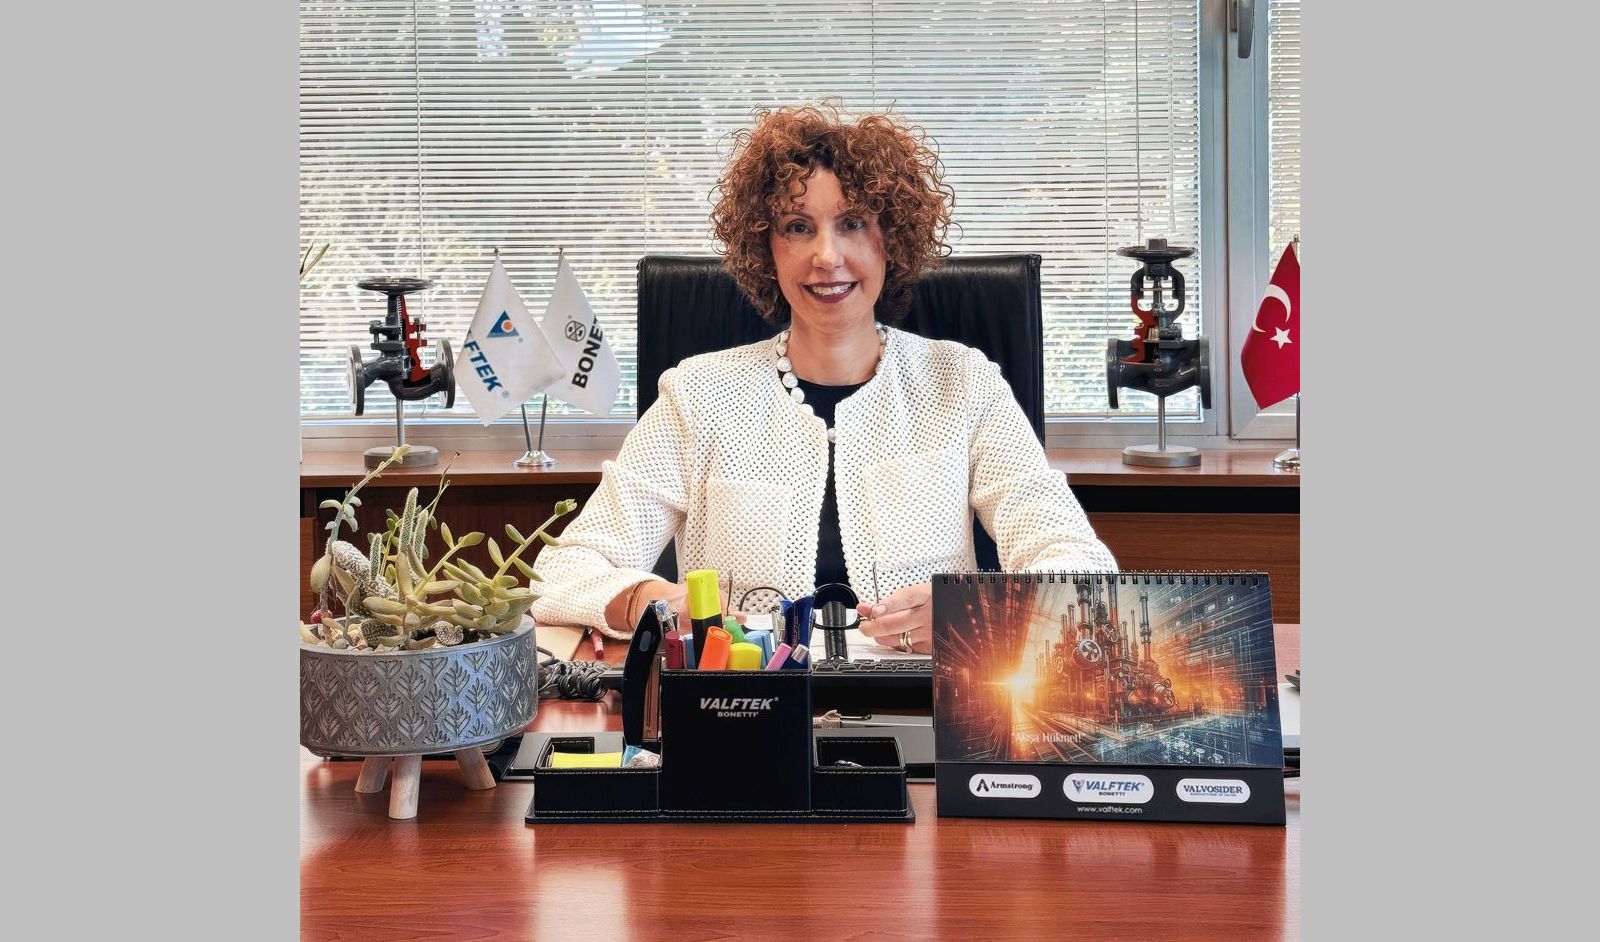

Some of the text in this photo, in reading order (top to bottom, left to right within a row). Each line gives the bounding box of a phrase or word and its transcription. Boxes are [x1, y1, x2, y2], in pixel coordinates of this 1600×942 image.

[464, 330, 503, 392] FTEK
[990, 781, 1034, 791] Armstrong
[1183, 784, 1243, 794] VALVOSIDER
[1076, 805, 1143, 814] www.valftek.com
